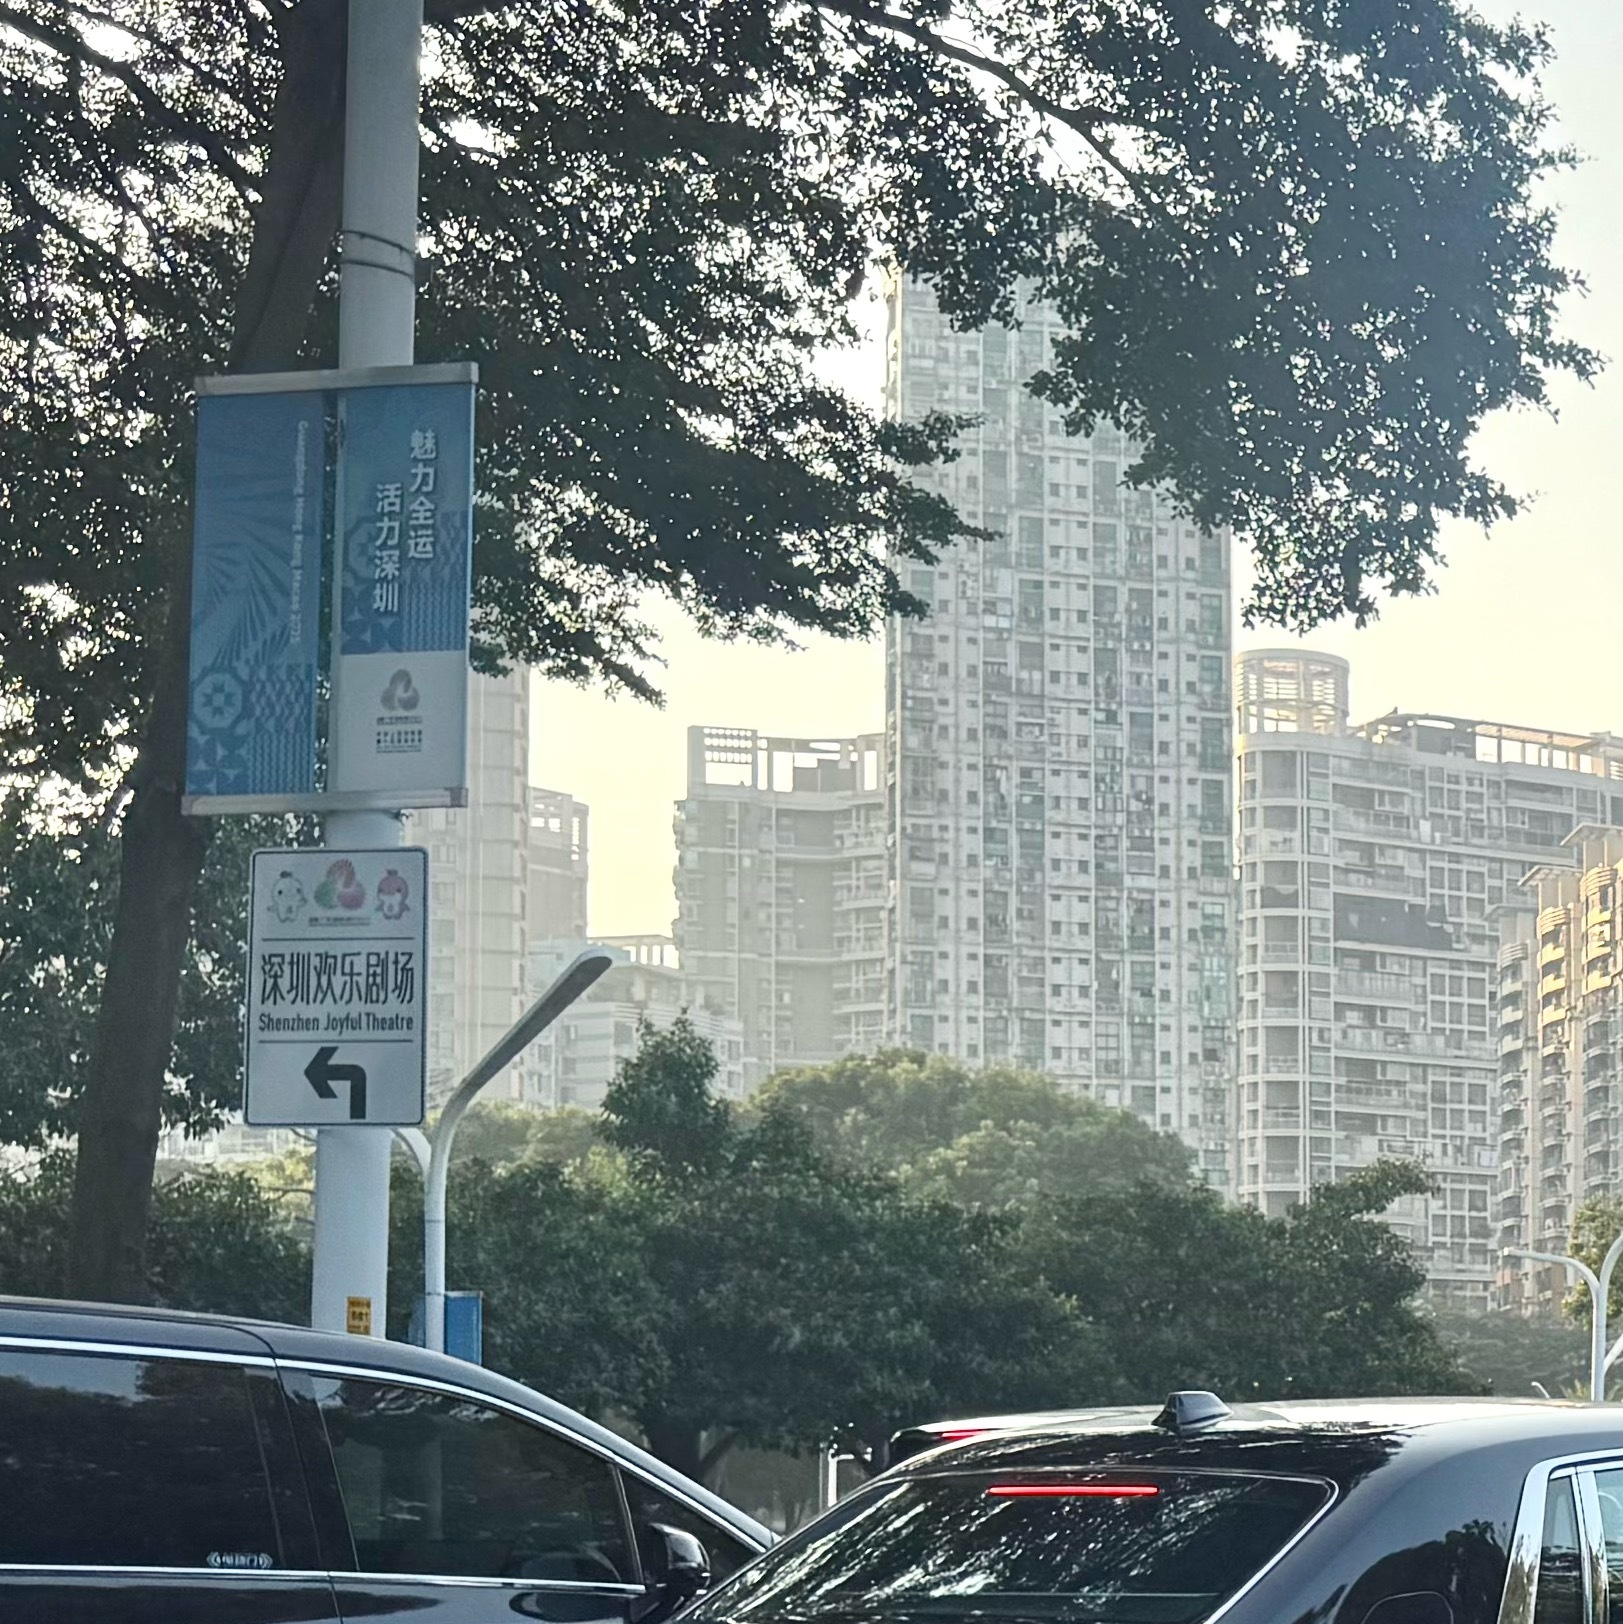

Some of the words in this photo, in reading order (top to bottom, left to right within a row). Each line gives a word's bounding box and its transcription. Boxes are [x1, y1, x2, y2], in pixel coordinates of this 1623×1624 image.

[407, 428, 437, 560] 魅力全运
[373, 482, 402, 613] 活力深圳
[259, 1013, 319, 1032] Shenzhen
[324, 1012, 362, 1035] Joyful
[366, 1012, 414, 1031] Theatre
[260, 950, 415, 1006] 深圳欢乐剧场
